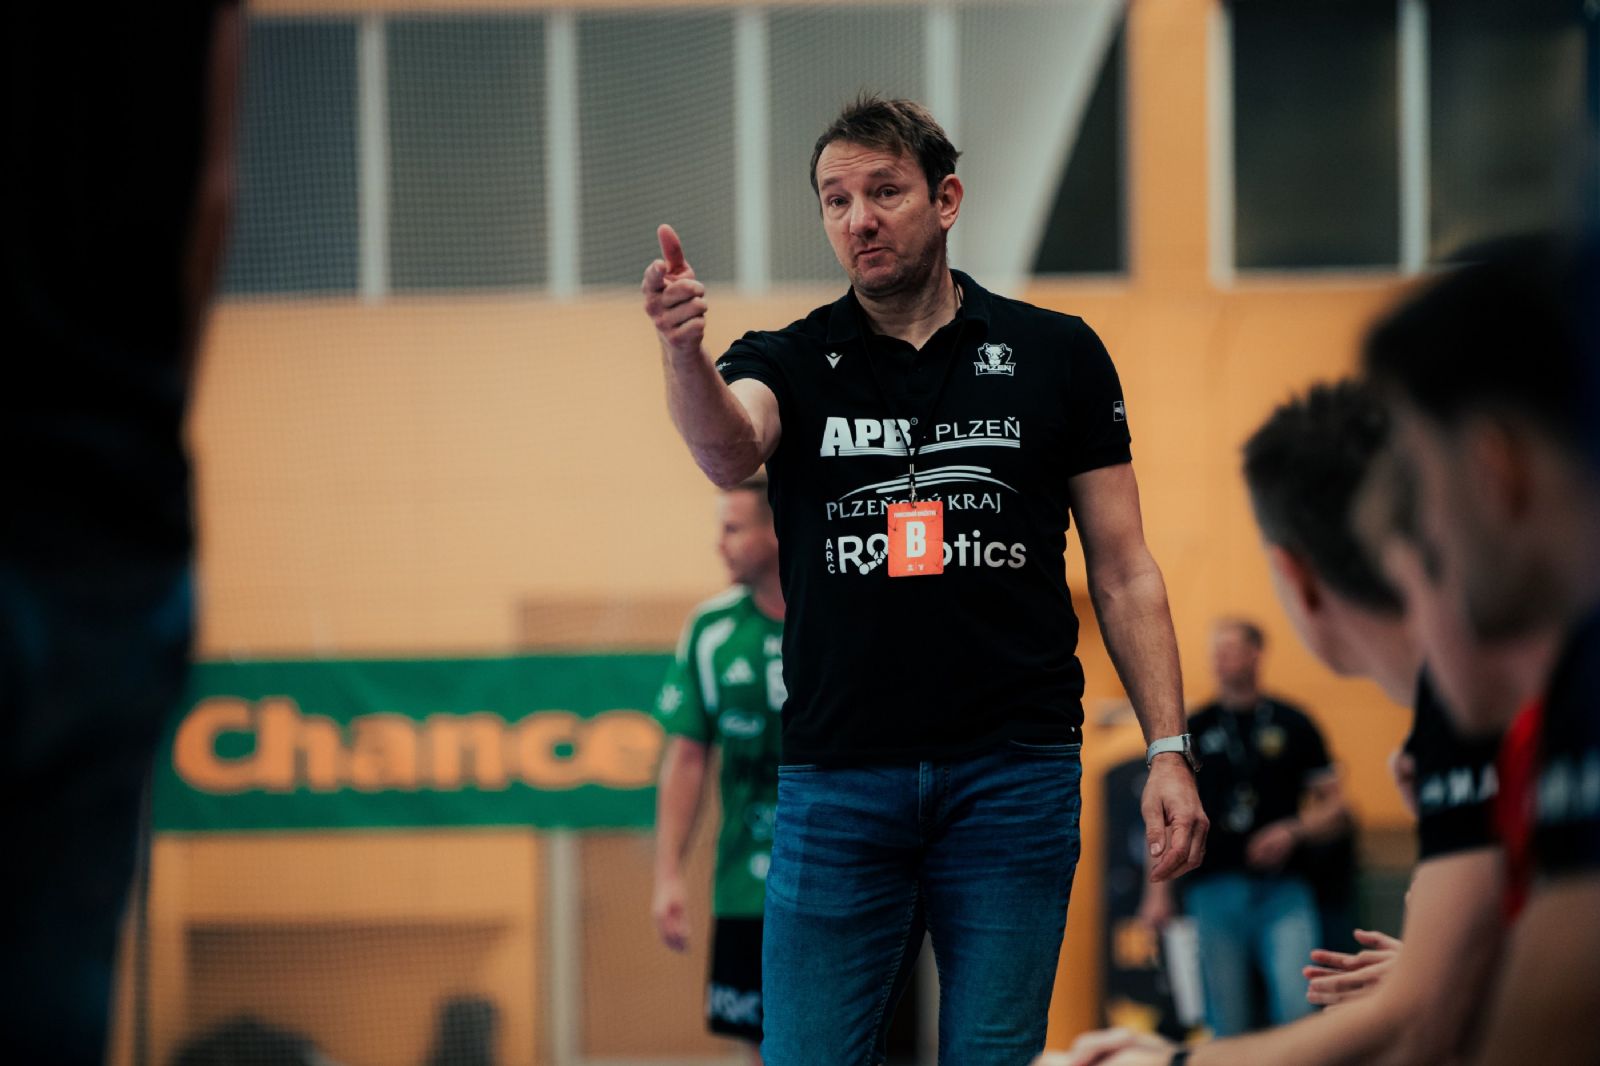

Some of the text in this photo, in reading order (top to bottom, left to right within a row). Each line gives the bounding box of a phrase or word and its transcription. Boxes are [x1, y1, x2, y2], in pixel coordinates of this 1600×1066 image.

[935, 416, 1021, 441] PLZEŇ
[948, 492, 1002, 514] KRAJ
[906, 521, 926, 558] B
[173, 696, 666, 793] Chance
